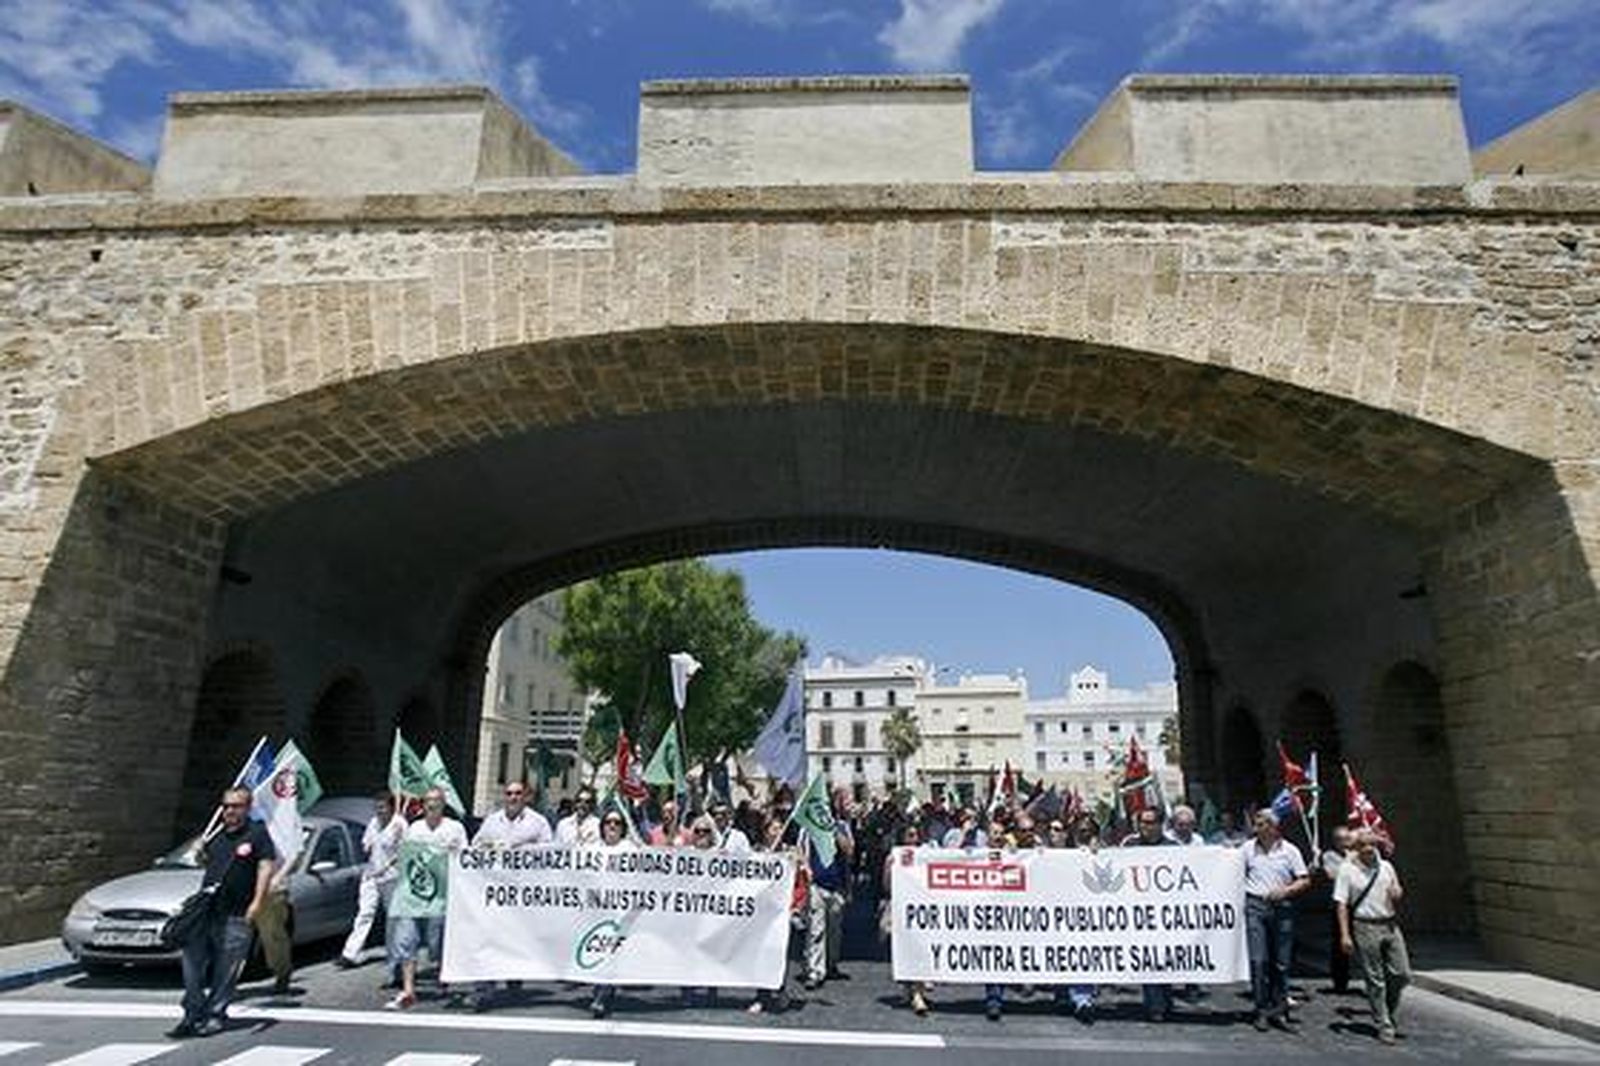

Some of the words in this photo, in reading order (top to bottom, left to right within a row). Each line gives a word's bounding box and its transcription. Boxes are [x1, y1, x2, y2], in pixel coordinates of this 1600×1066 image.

[502, 850, 571, 870] RECHAZA
[576, 851, 603, 871] LAS
[676, 856, 704, 875] DEL
[708, 857, 783, 881] GOBIERNO
[1131, 865, 1198, 892] UCA
[485, 885, 518, 907] POR
[522, 885, 583, 911] GRAVES,
[586, 888, 655, 910] INJUSTAS
[661, 891, 672, 911] Y
[674, 892, 755, 917] EVITABLES
[905, 904, 940, 930] POR
[945, 905, 969, 930] UN
[974, 905, 1049, 931] SERVICIO
[1054, 905, 1128, 931] PUBLICO
[1133, 905, 1156, 930] DE
[1161, 903, 1235, 930] CALIDAD
[931, 944, 941, 970] Y
[948, 944, 1015, 971] CONTRA
[1020, 946, 1040, 971] EL
[1045, 945, 1125, 972] RECORTE
[1130, 945, 1215, 972] SALARIAL
